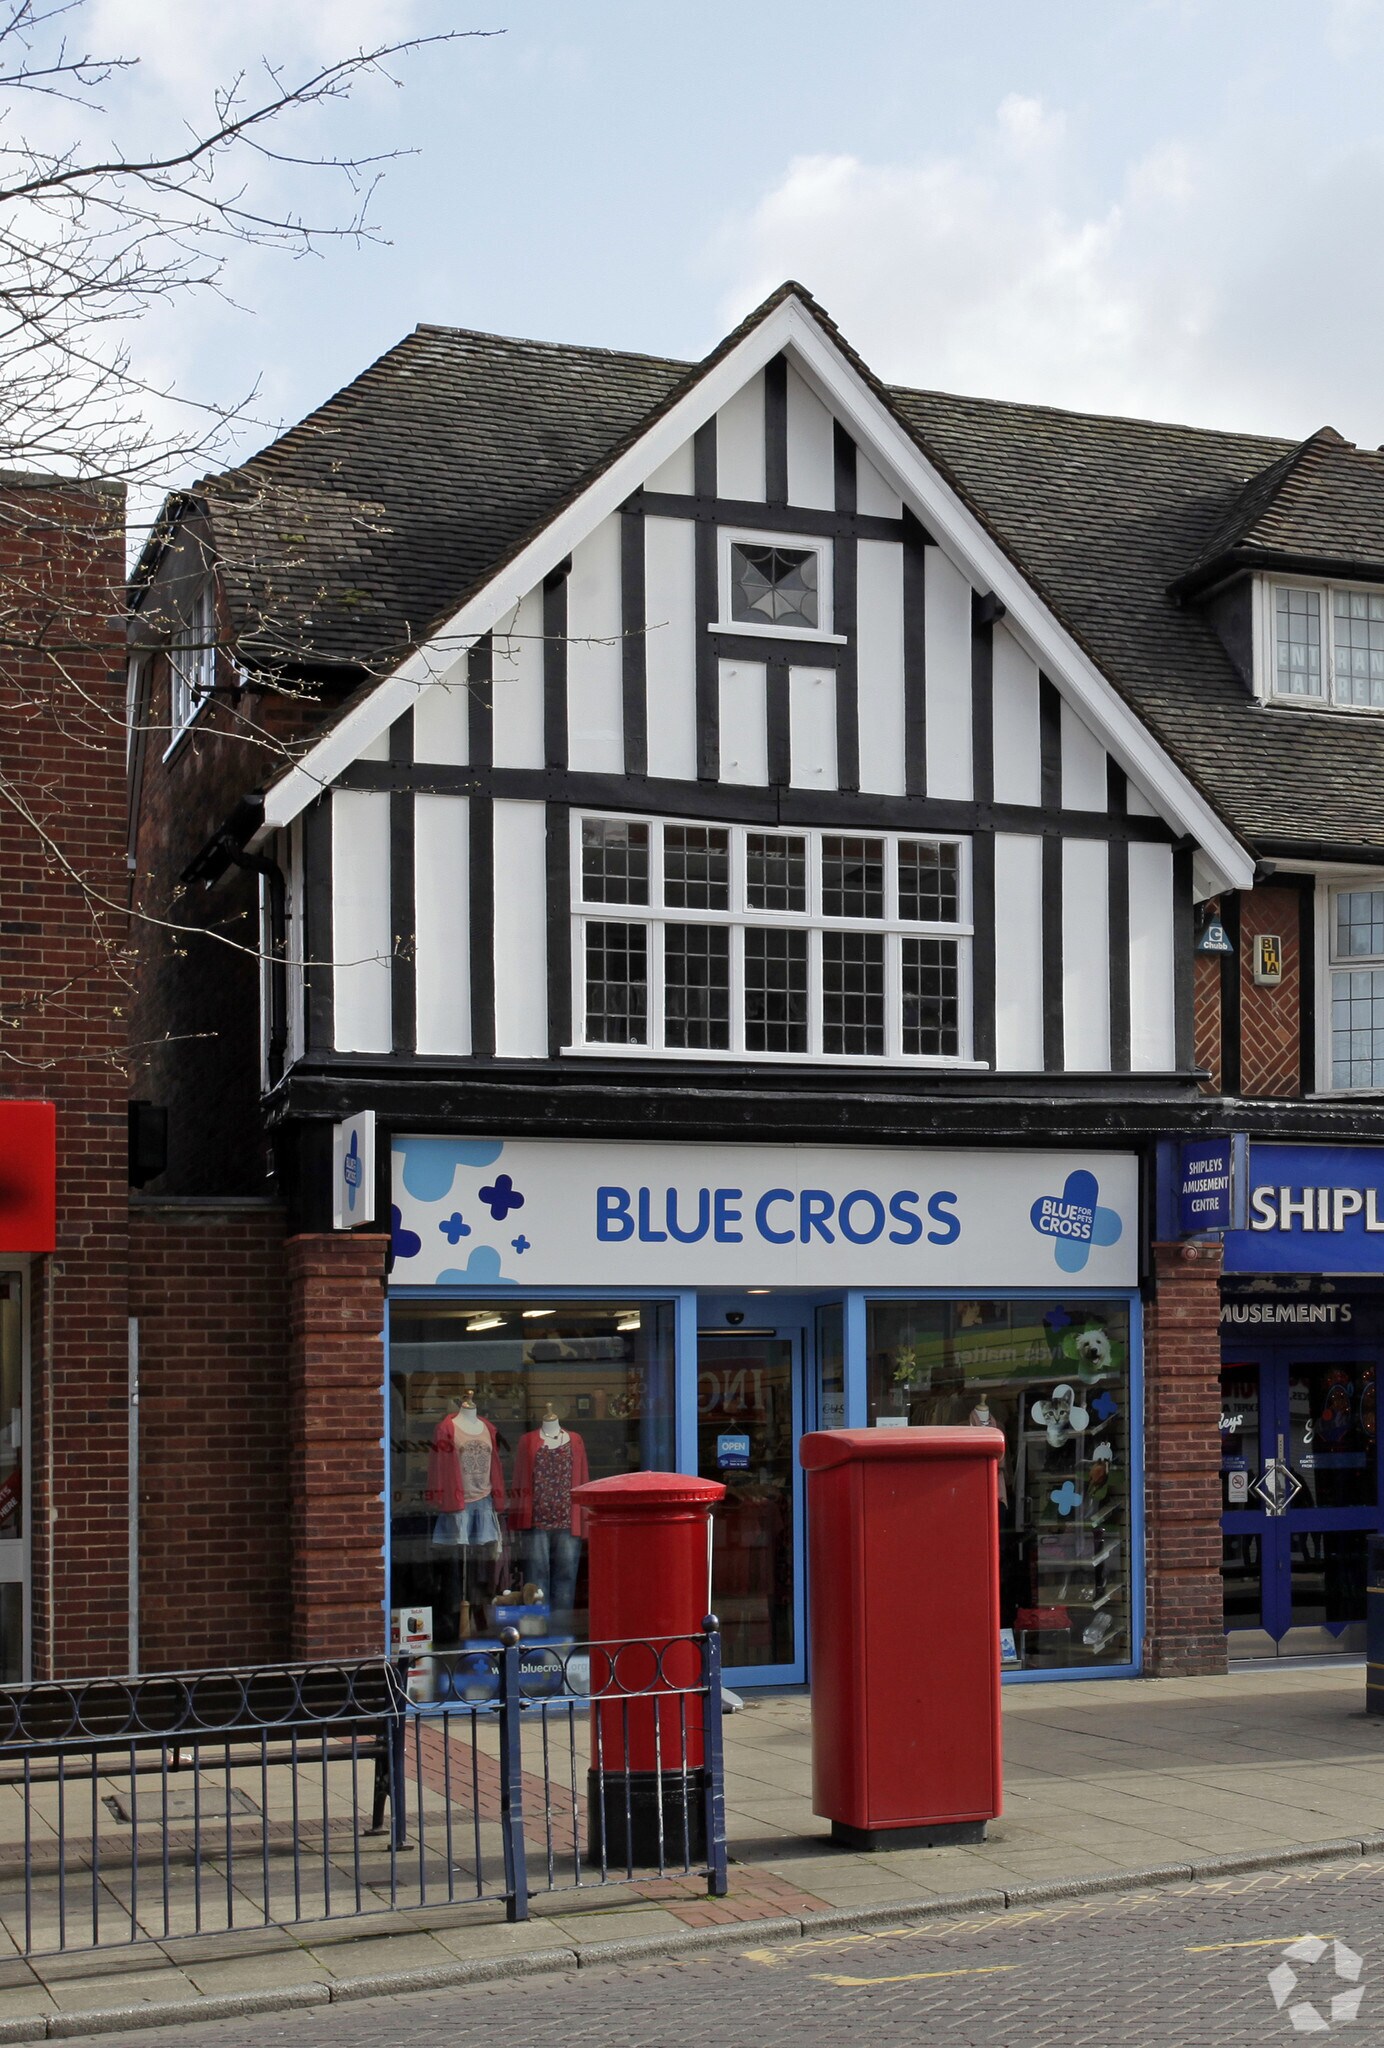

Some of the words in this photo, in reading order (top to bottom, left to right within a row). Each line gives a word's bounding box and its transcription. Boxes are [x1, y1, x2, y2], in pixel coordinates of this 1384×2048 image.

[1203, 941, 1228, 950] Chubb
[1189, 1158, 1222, 1175] SHIPLEYS
[1182, 1176, 1229, 1194] AMUSEMENT
[1041, 1199, 1078, 1220] BLUE
[1078, 1206, 1092, 1216] FOR
[1191, 1197, 1219, 1212] CENTRE
[596, 1186, 744, 1244] BLUE
[755, 1188, 961, 1245] CROSS
[1076, 1215, 1093, 1224] PETS
[1039, 1215, 1091, 1239] CROSS
[1220, 1303, 1352, 1323] MUSEMENTS
[722, 1442, 746, 1450] OPEN
